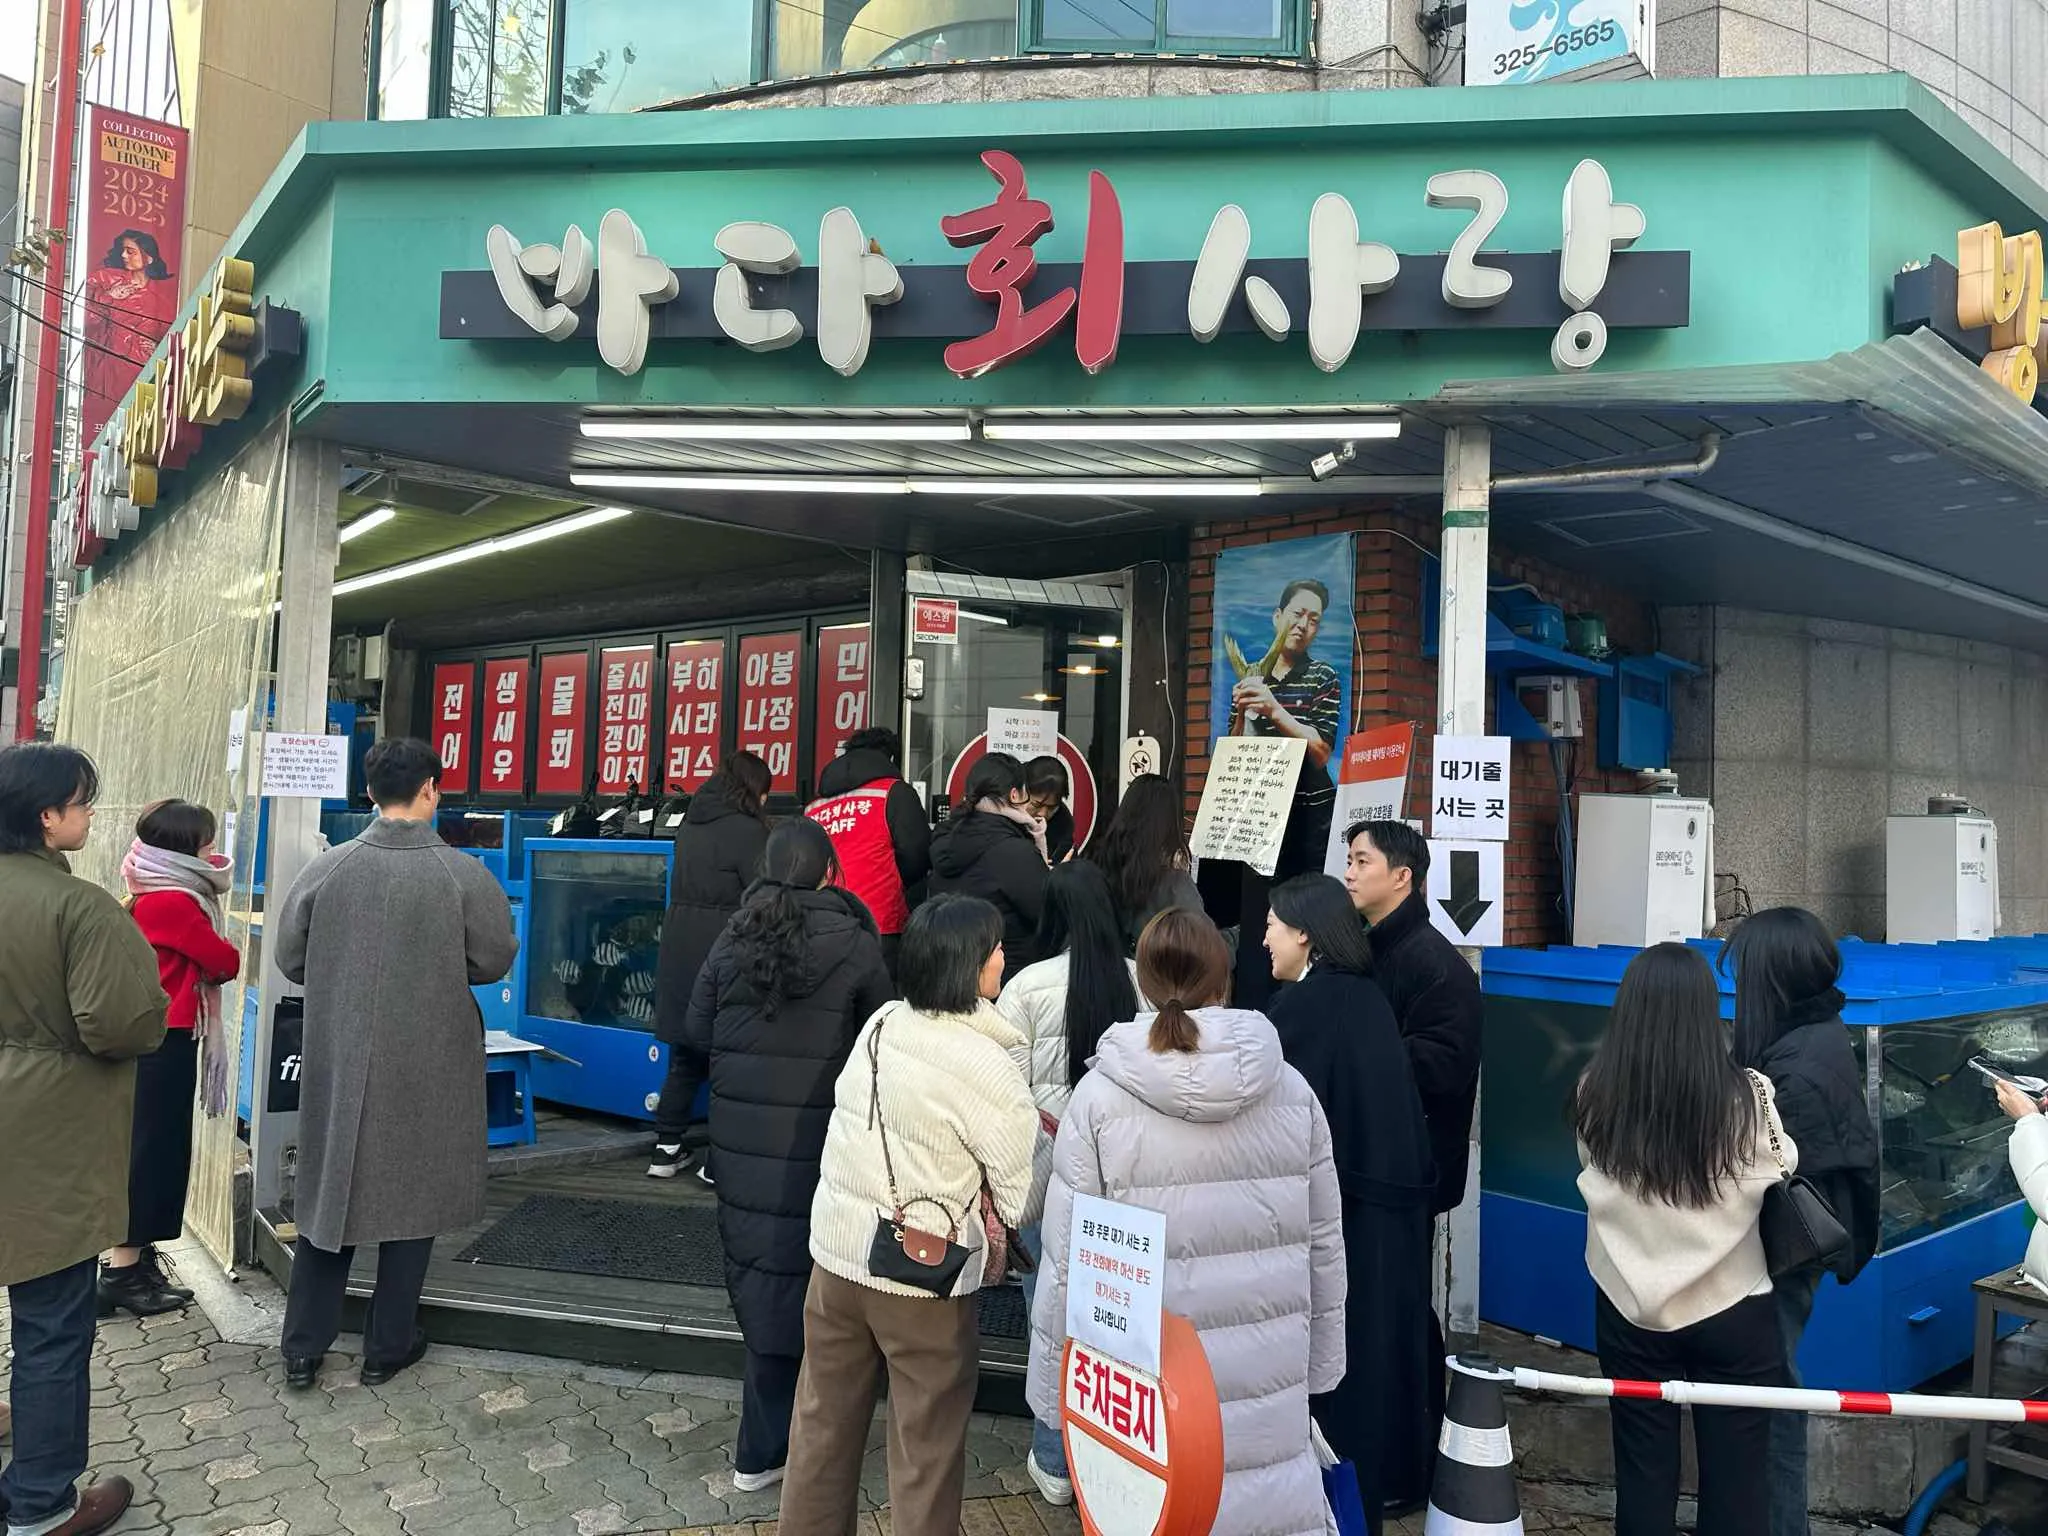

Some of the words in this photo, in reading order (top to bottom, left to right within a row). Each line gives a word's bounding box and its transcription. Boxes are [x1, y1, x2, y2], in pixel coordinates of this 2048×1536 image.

[1493, 19, 1615, 75] 325-6565
[103, 119, 175, 147] COLLECTION
[104, 136, 174, 163] AUTOMNE
[117, 151, 161, 173] HIVER
[104, 166, 168, 203] 2024
[104, 192, 166, 227] 2025
[486, 150, 1646, 379] 바다회사랑
[694, 657, 720, 777] 히라스
[768, 650, 795, 777] 붕장어
[834, 641, 868, 758] 민어
[440, 683, 465, 771] 전어
[492, 671, 519, 783] 생새우
[548, 675, 576, 769] 물회
[602, 661, 626, 784] 줄전갱이
[626, 661, 649, 784] 시마아지
[668, 660, 694, 778] 부시리
[1440, 761, 1502, 783] 대기줄
[824, 818, 857, 835] AFF
[1435, 796, 1478, 819] 서는
[1485, 797, 1506, 820] 곳
[280, 1055, 302, 1081] fi
[1082, 1219, 1095, 1237] 포장
[1096, 1224, 1109, 1241] 주문
[1111, 1227, 1124, 1246] 대기
[1125, 1232, 1140, 1251] 서는
[1142, 1236, 1150, 1254] 곳
[1079, 1248, 1092, 1266] 포장
[1120, 1261, 1134, 1281] 하신
[1136, 1267, 1151, 1285] 분도
[1123, 1291, 1131, 1309] 곳
[1093, 1305, 1127, 1334] 감사합니다
[1073, 1351, 1156, 1452] 주차금지
